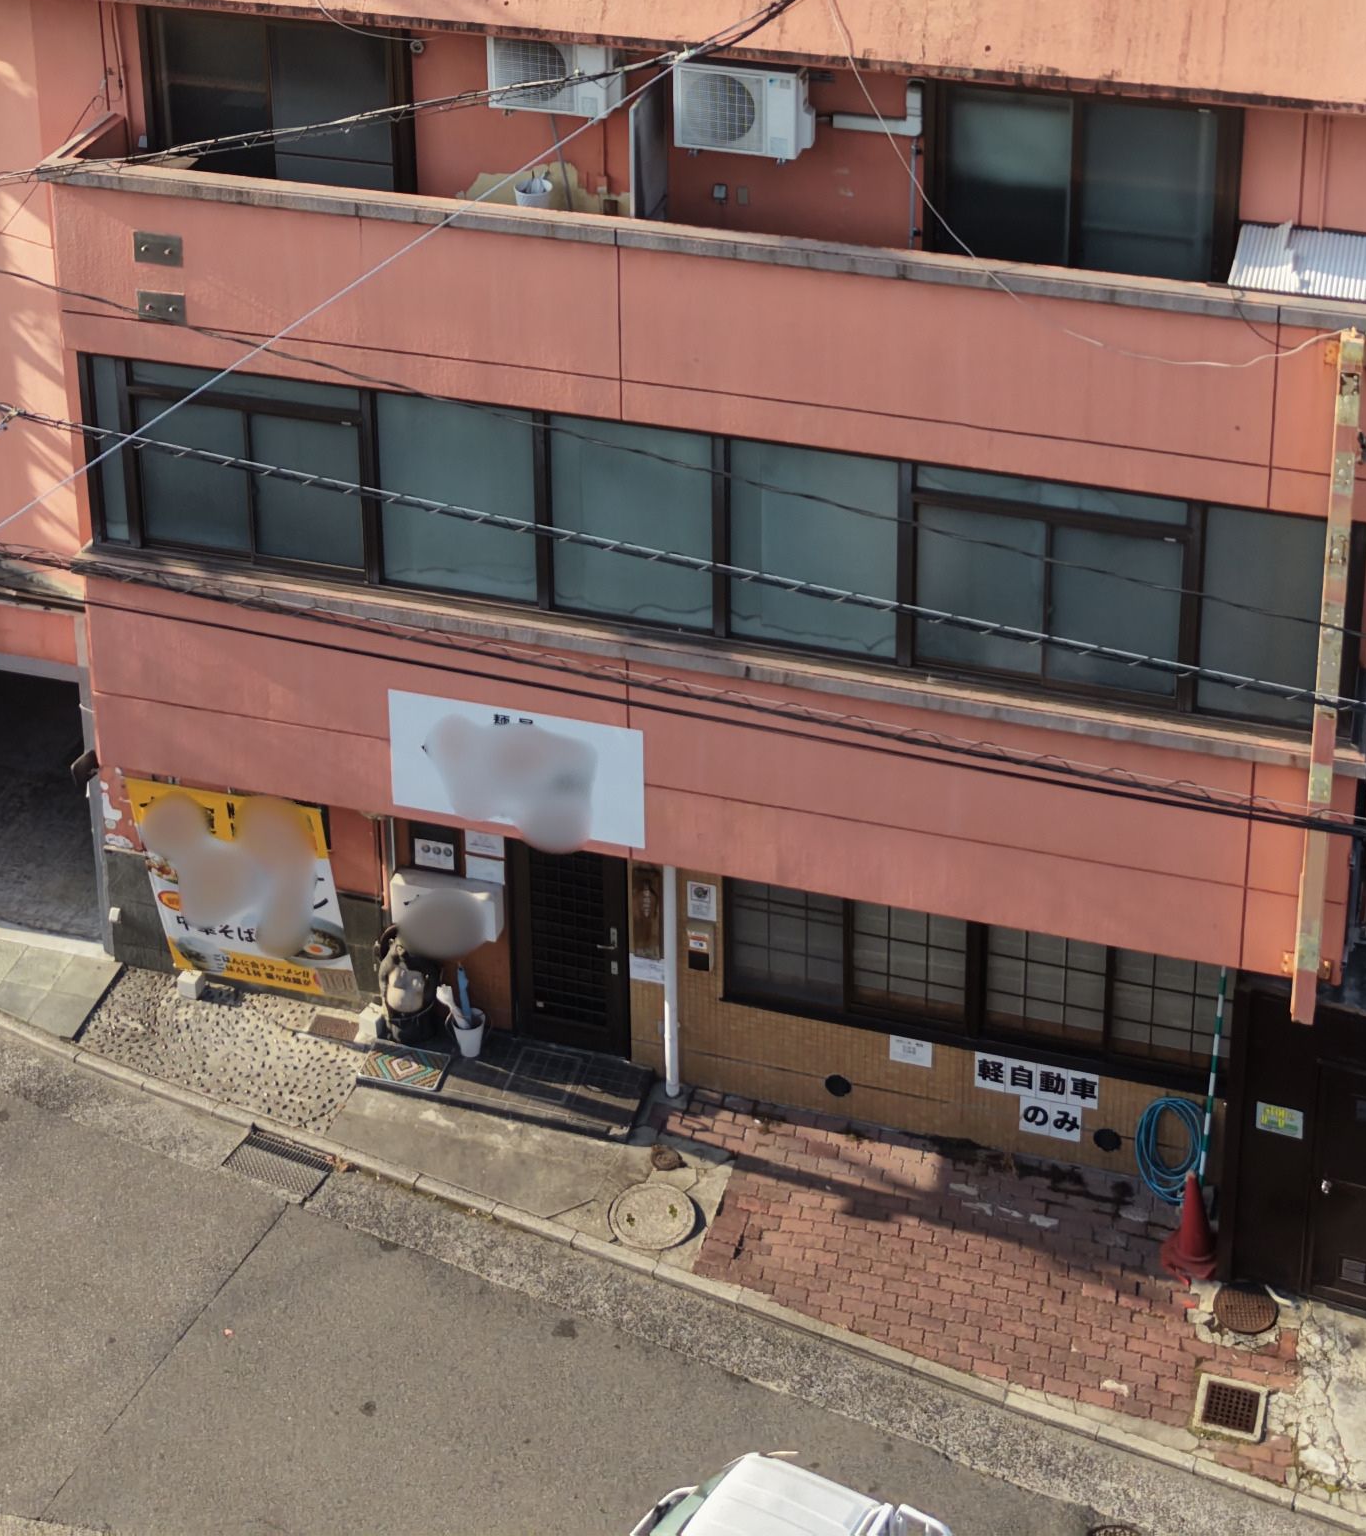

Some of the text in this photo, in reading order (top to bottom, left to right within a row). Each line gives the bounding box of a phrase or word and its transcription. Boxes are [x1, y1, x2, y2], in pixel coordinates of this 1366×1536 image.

[977, 1058, 1098, 1100] 軽自動車
[1023, 1105, 1080, 1133] のみ
